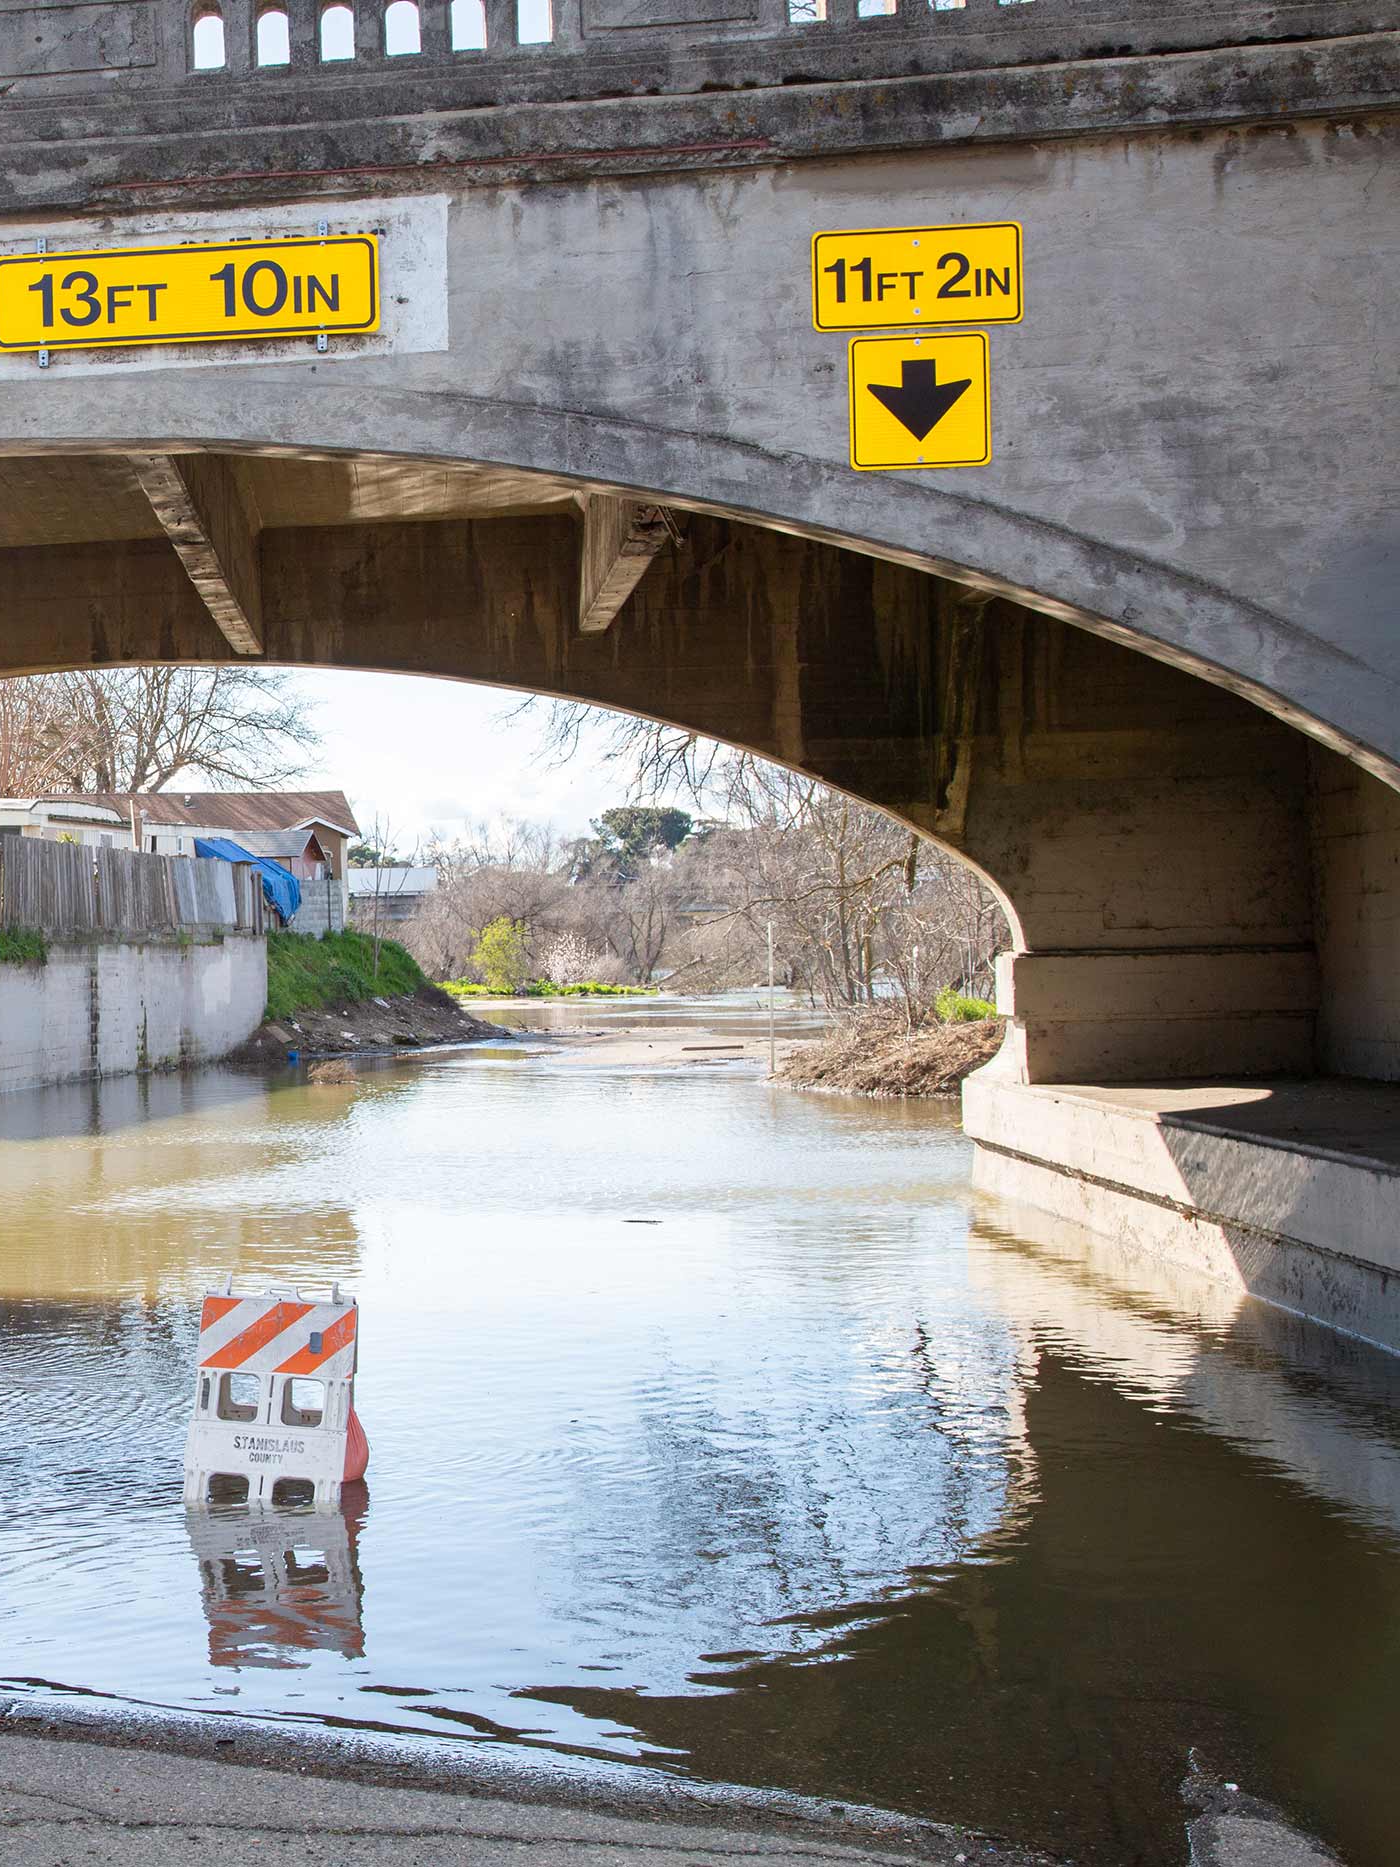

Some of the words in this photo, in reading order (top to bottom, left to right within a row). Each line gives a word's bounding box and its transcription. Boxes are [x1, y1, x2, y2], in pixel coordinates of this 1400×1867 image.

[28, 270, 168, 328] 13FT
[209, 260, 341, 318] 10IN
[824, 257, 924, 303] 11FT
[936, 252, 1011, 299] 2IN
[233, 1435, 305, 1454] STANISLAUS
[248, 1452, 284, 1465] COUNTY
